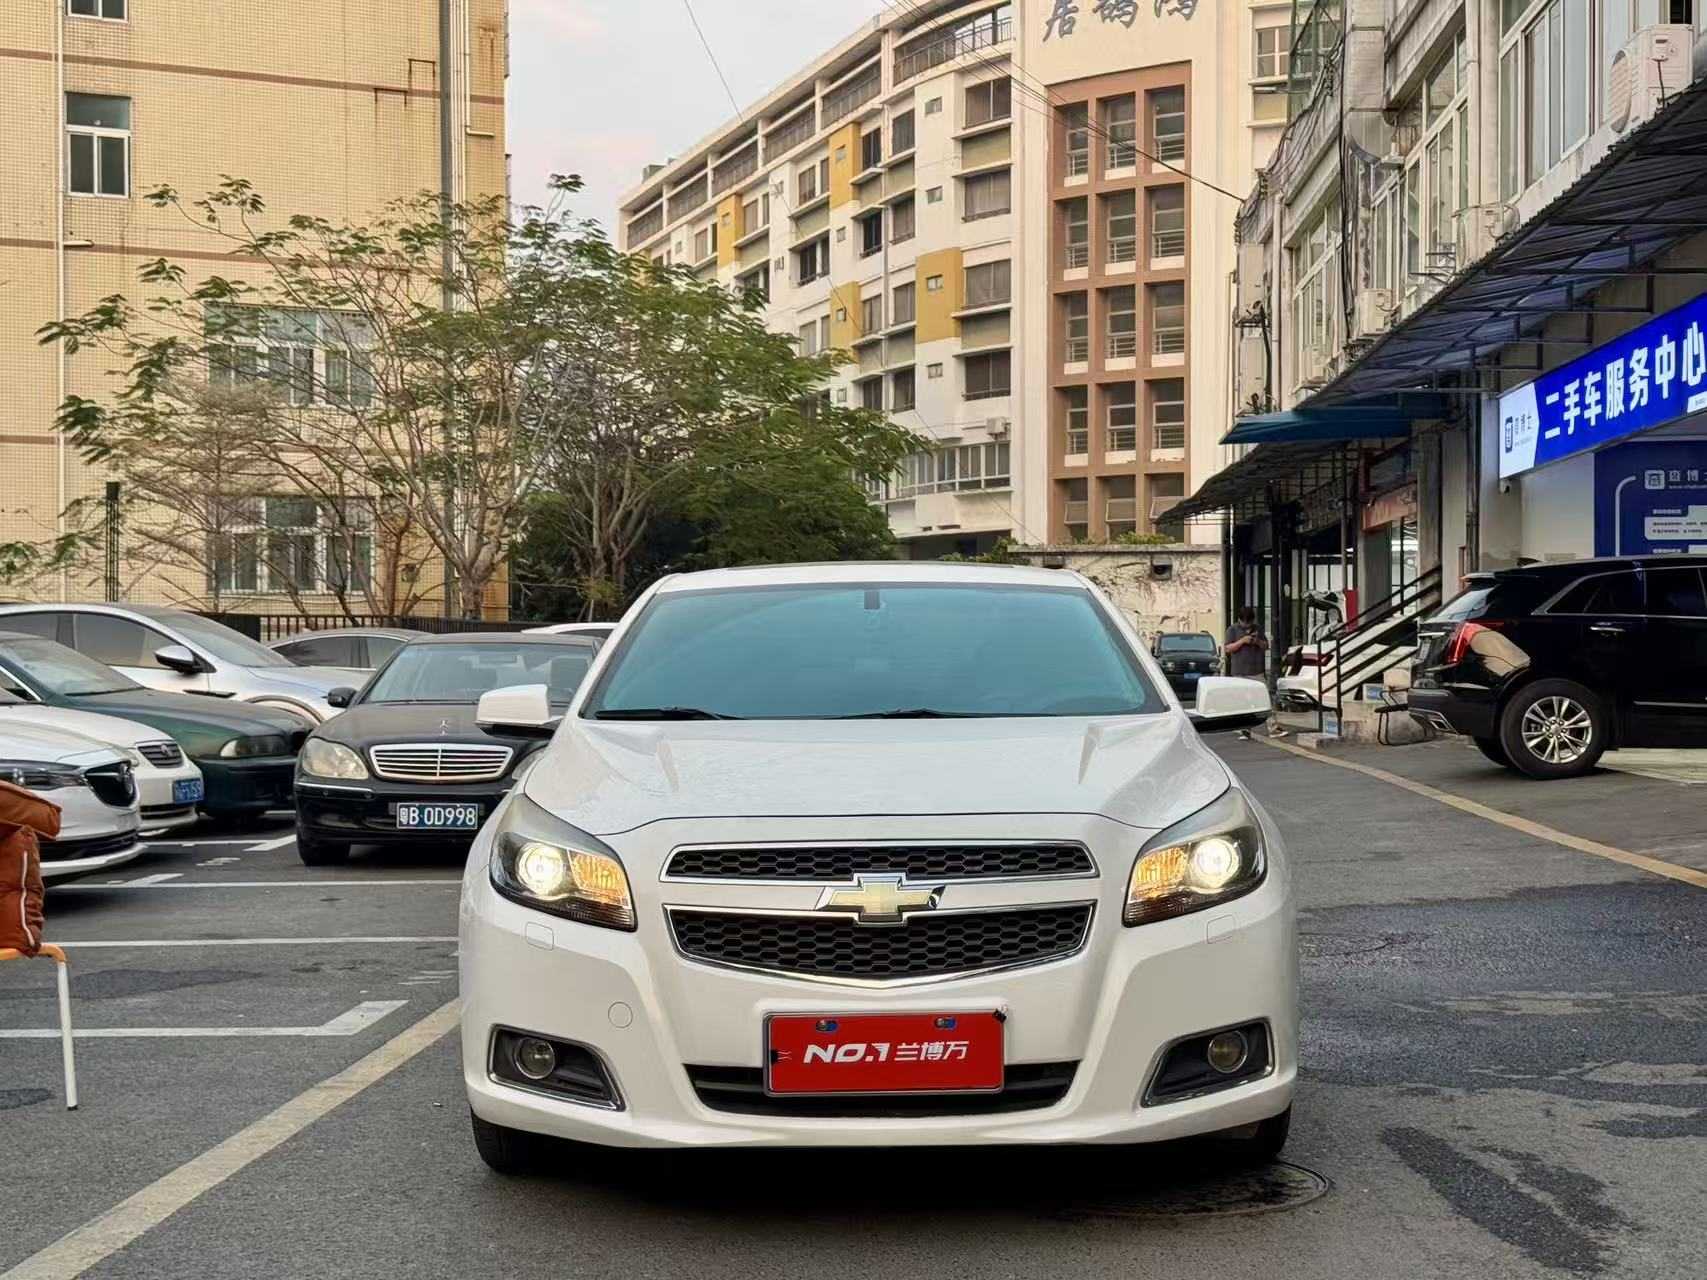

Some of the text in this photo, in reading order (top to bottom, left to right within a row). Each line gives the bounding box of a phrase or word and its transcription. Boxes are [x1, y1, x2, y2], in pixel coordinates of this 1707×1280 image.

[1545, 321, 1706, 440] 二手车服务中心
[803, 1040, 969, 1063] NO.1 兰博万
